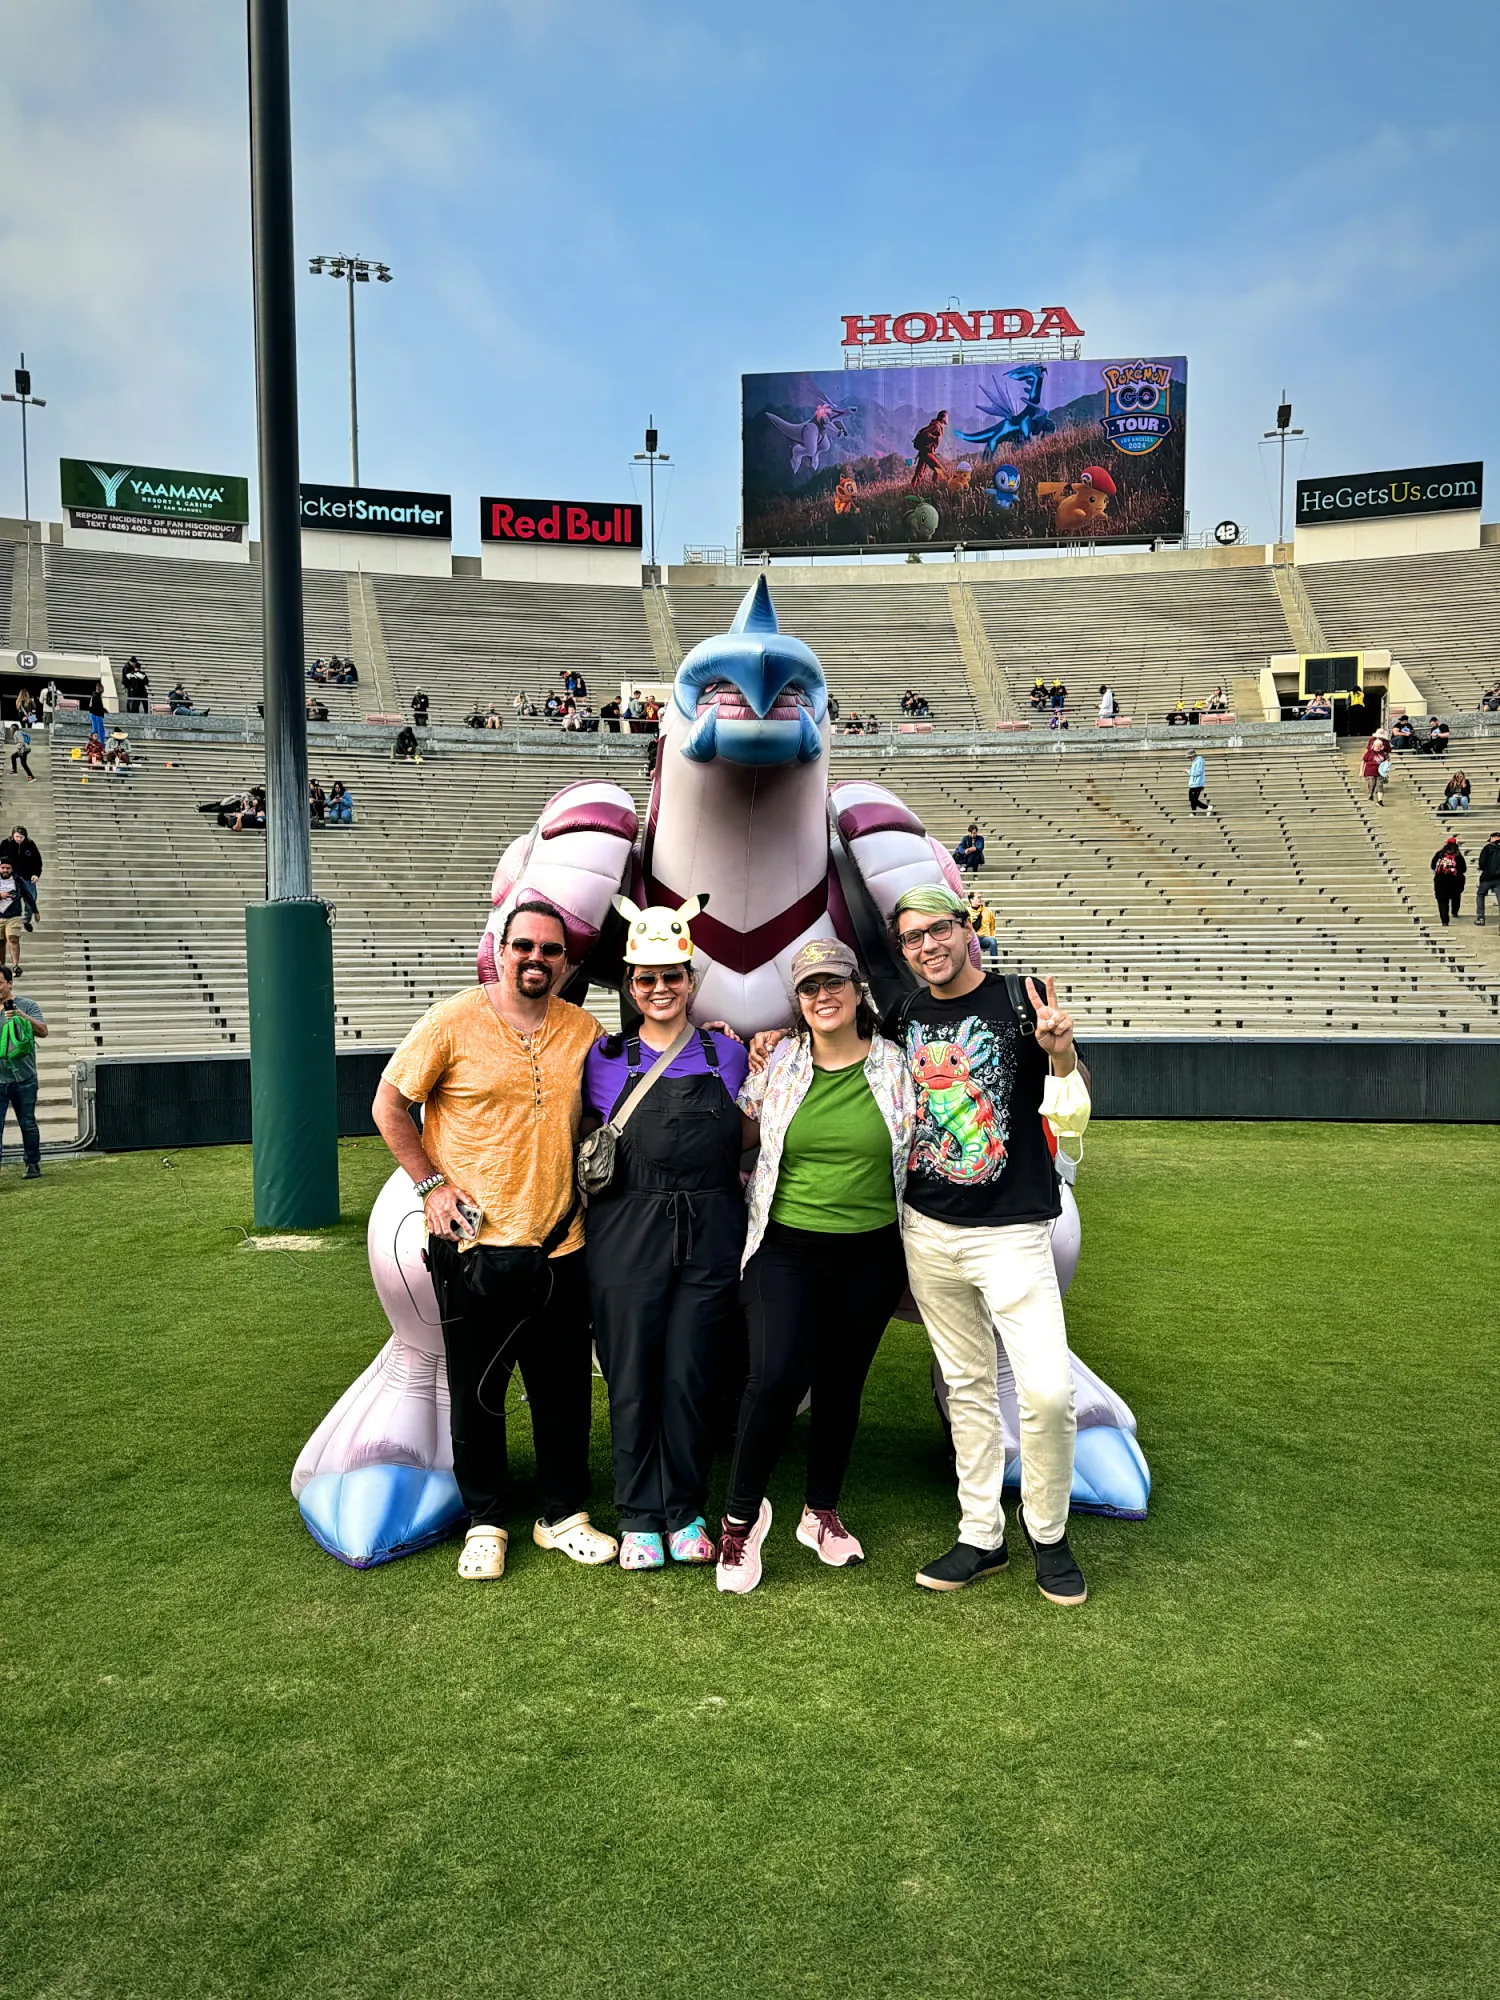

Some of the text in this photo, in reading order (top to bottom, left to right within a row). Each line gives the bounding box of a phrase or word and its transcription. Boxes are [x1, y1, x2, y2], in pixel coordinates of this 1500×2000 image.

[841, 307, 1085, 346] HONDA
[1119, 385, 1157, 408] GO
[1117, 417, 1160, 432] TOUR
[141, 497, 173, 505] RESORT
[184, 501, 213, 509] CASINO
[1301, 480, 1478, 512] HeGetsUs.com
[298, 495, 444, 525] icketSmarter
[75, 511, 108, 521] REPORT
[109, 515, 152, 526] INCIDENTS
[167, 520, 184, 528] FAN
[184, 521, 236, 533] MISCONDUCT
[85, 520, 107, 529] TEXT
[107, 522, 130, 532] (626)
[151, 527, 168, 535] 5119
[169, 528, 191, 537] WITH
[191, 530, 224, 540] DETAILS
[491, 503, 632, 543] Red Bull
[1216, 524, 1236, 542] 42
[20, 654, 34, 667] 13
